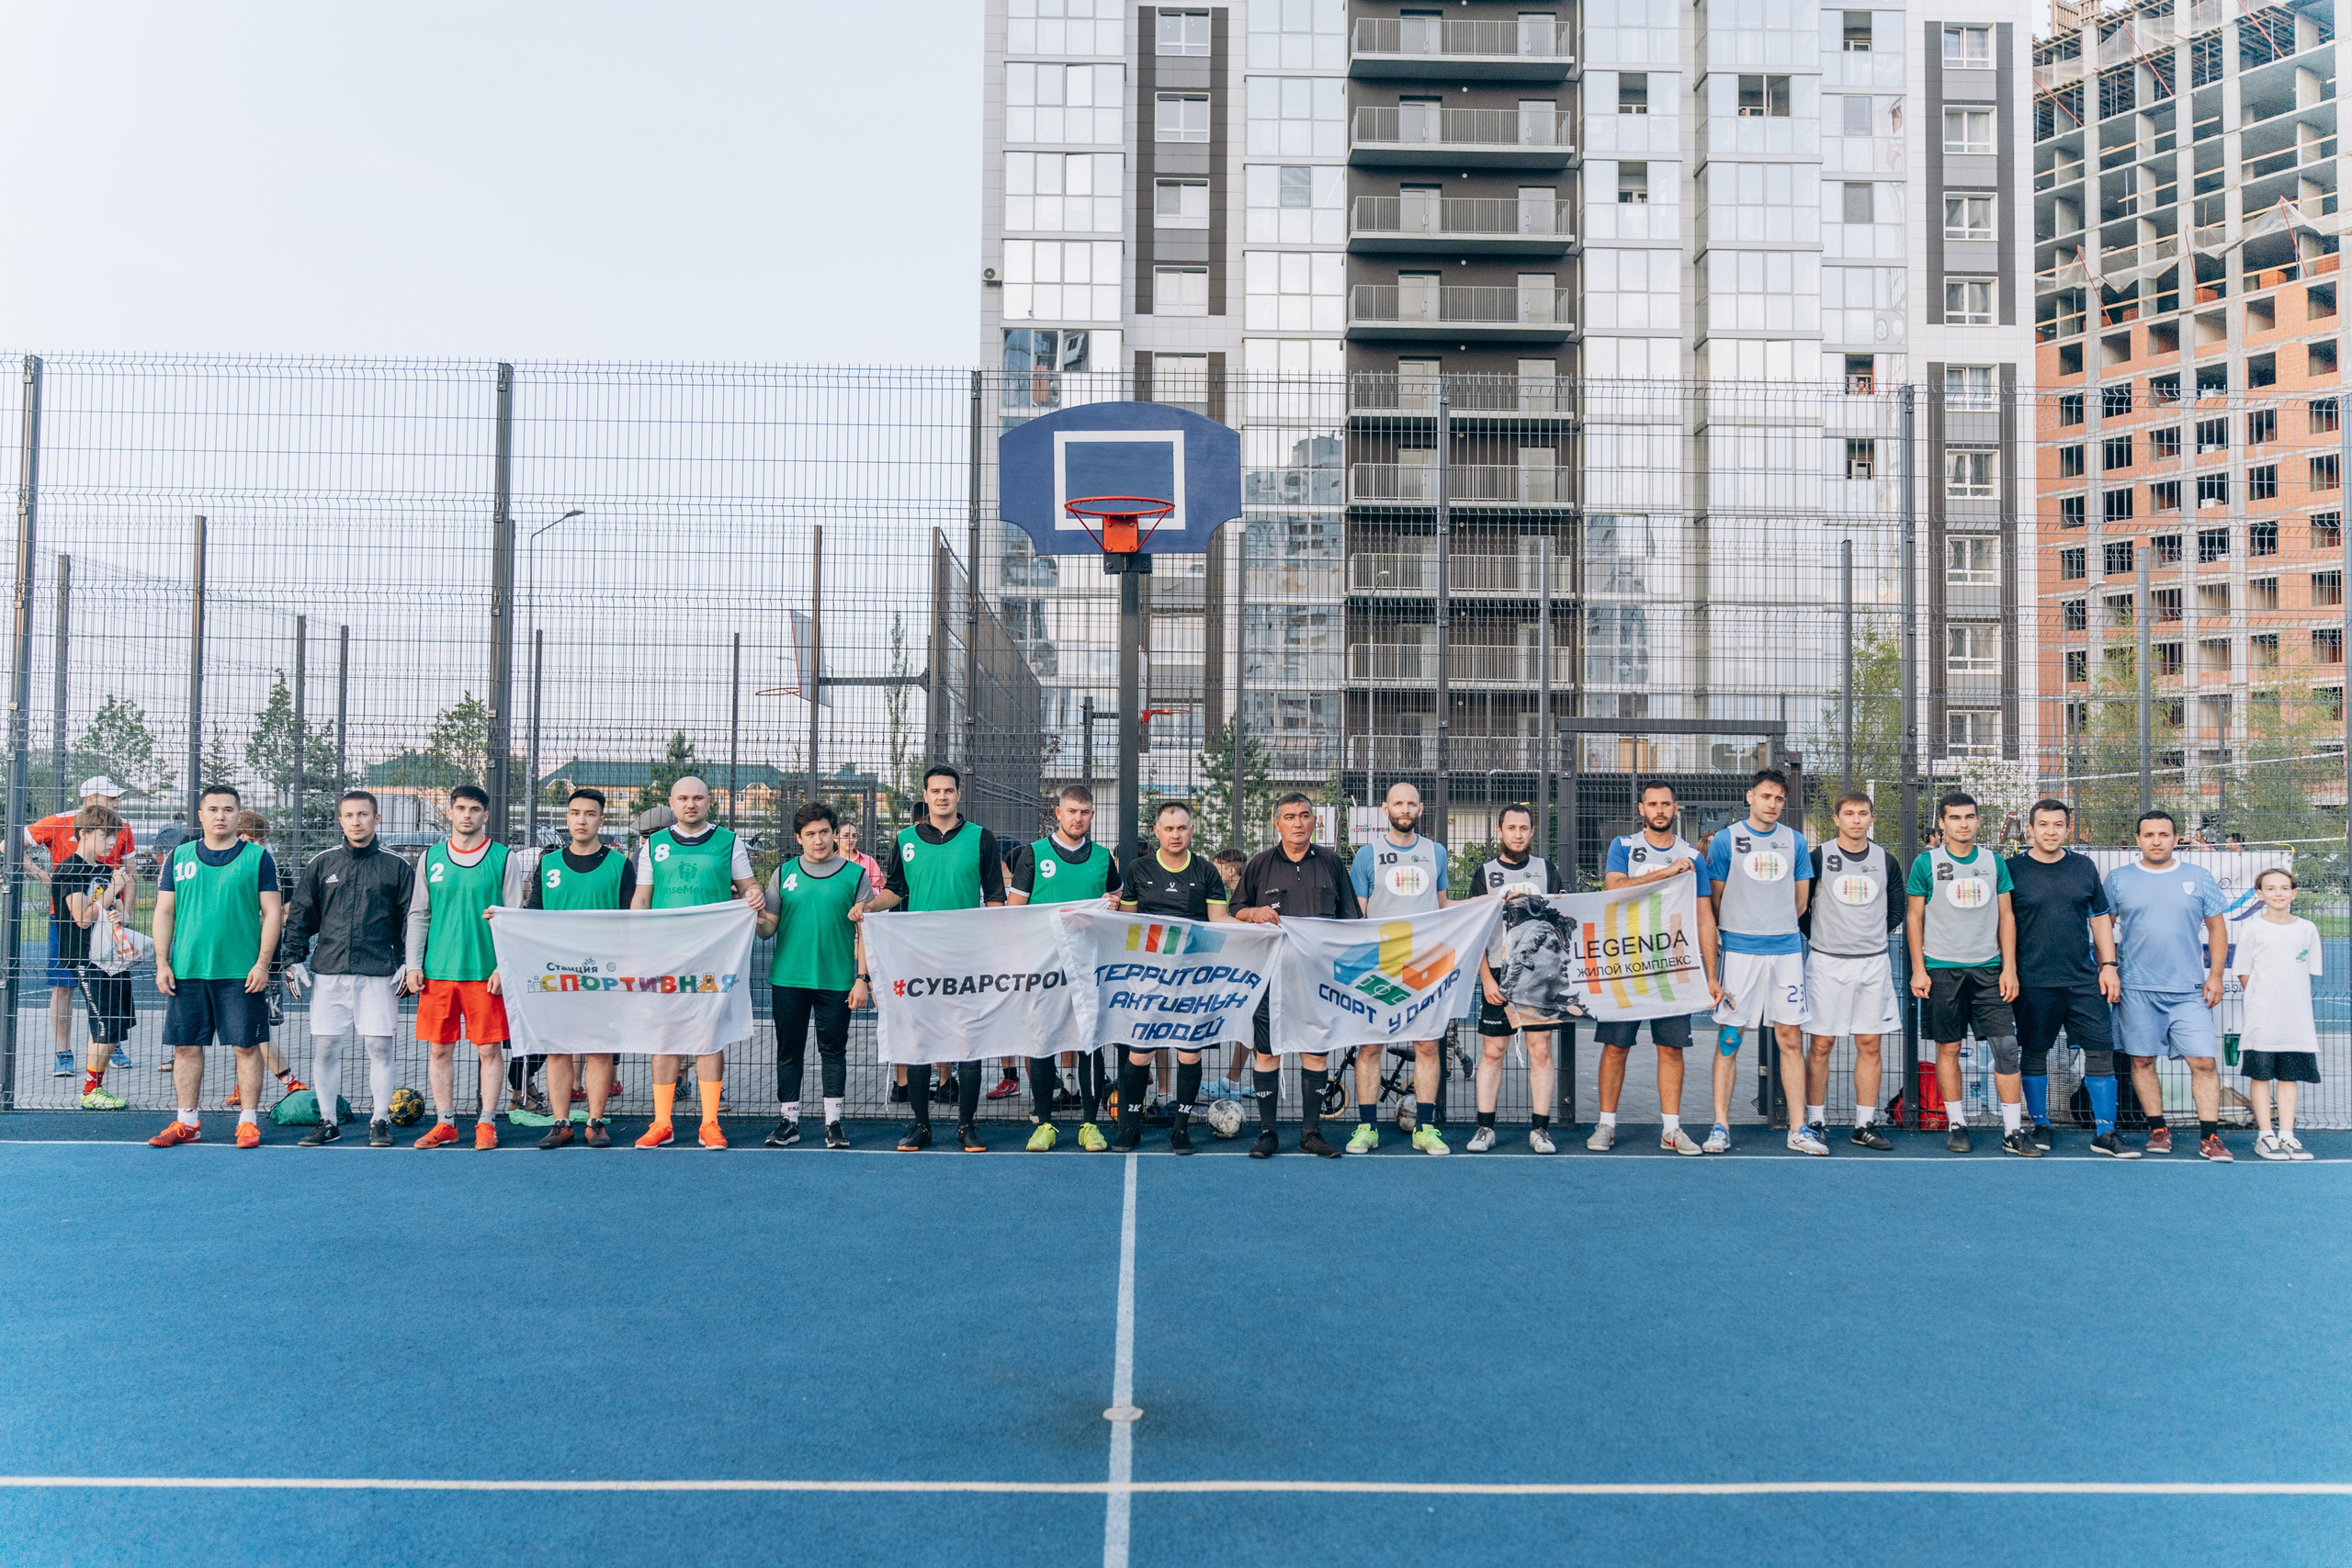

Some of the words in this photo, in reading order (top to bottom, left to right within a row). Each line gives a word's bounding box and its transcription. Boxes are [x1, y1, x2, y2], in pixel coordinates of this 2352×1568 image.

[654, 843, 671, 863] 8
[902, 842, 915, 863] 6
[1631, 847, 1647, 863] 6
[1735, 836, 1752, 854] 5
[1378, 852, 1398, 865] 10
[1826, 854, 1843, 872] 9
[175, 861, 197, 882] 10
[429, 863, 444, 883] 2
[546, 868, 561, 888] 3
[1040, 861, 1057, 878] 9
[1937, 862, 1953, 881] 2
[782, 873, 797, 892] 4
[1488, 872, 1504, 888] 8
[1574, 929, 1689, 960] LEGENDA
[546, 962, 598, 974] Станция
[1577, 963, 1623, 977] ЖИЛОЙ
[1625, 955, 1691, 973] КОМПЛЕКС
[540, 973, 738, 994] СПОРТИВНАЯ
[1093, 963, 1261, 990] ТЕРРИТОРИЯ
[1108, 990, 1249, 1014] АКТИВНЫХ
[1318, 983, 1377, 1024] СПОРТ
[1388, 1012, 1401, 1034] У
[1131, 1016, 1225, 1042] ЛЮДЕЙ
[1127, 1103, 1142, 1112] 2K
[1178, 1103, 1193, 1114] 2K
